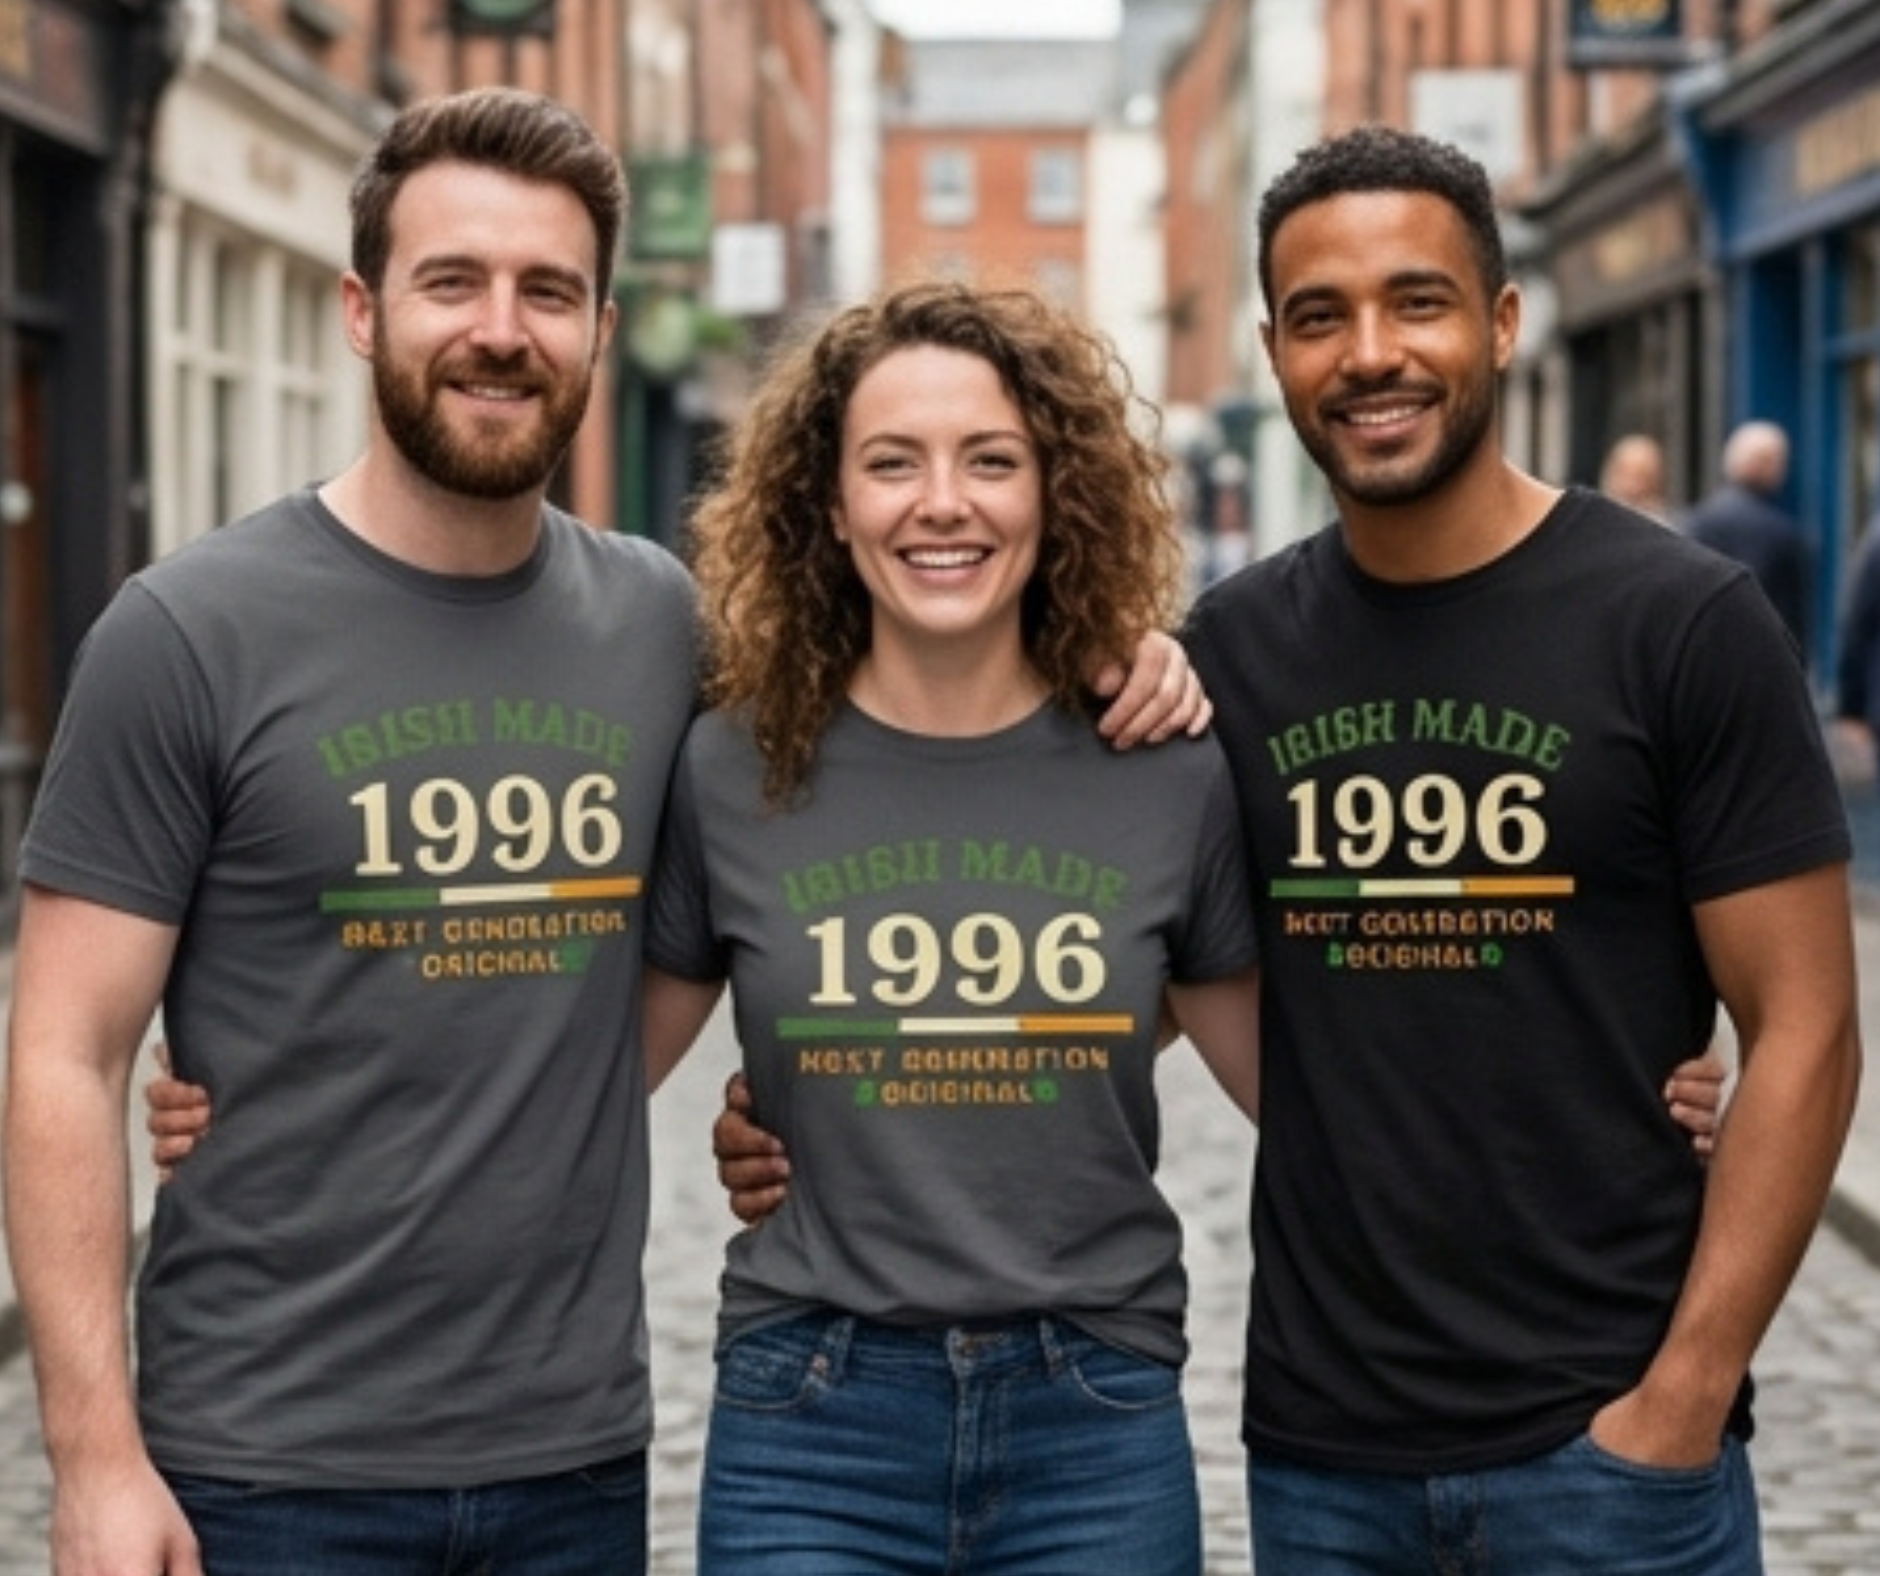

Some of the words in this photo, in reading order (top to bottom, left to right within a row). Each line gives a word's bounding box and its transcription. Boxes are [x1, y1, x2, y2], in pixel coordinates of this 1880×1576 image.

[494, 697, 633, 768] MADE
[1412, 698, 1571, 773] MADE
[348, 773, 623, 876] 1996
[1286, 773, 1548, 868] 1996
[806, 911, 1106, 1008] 1996
